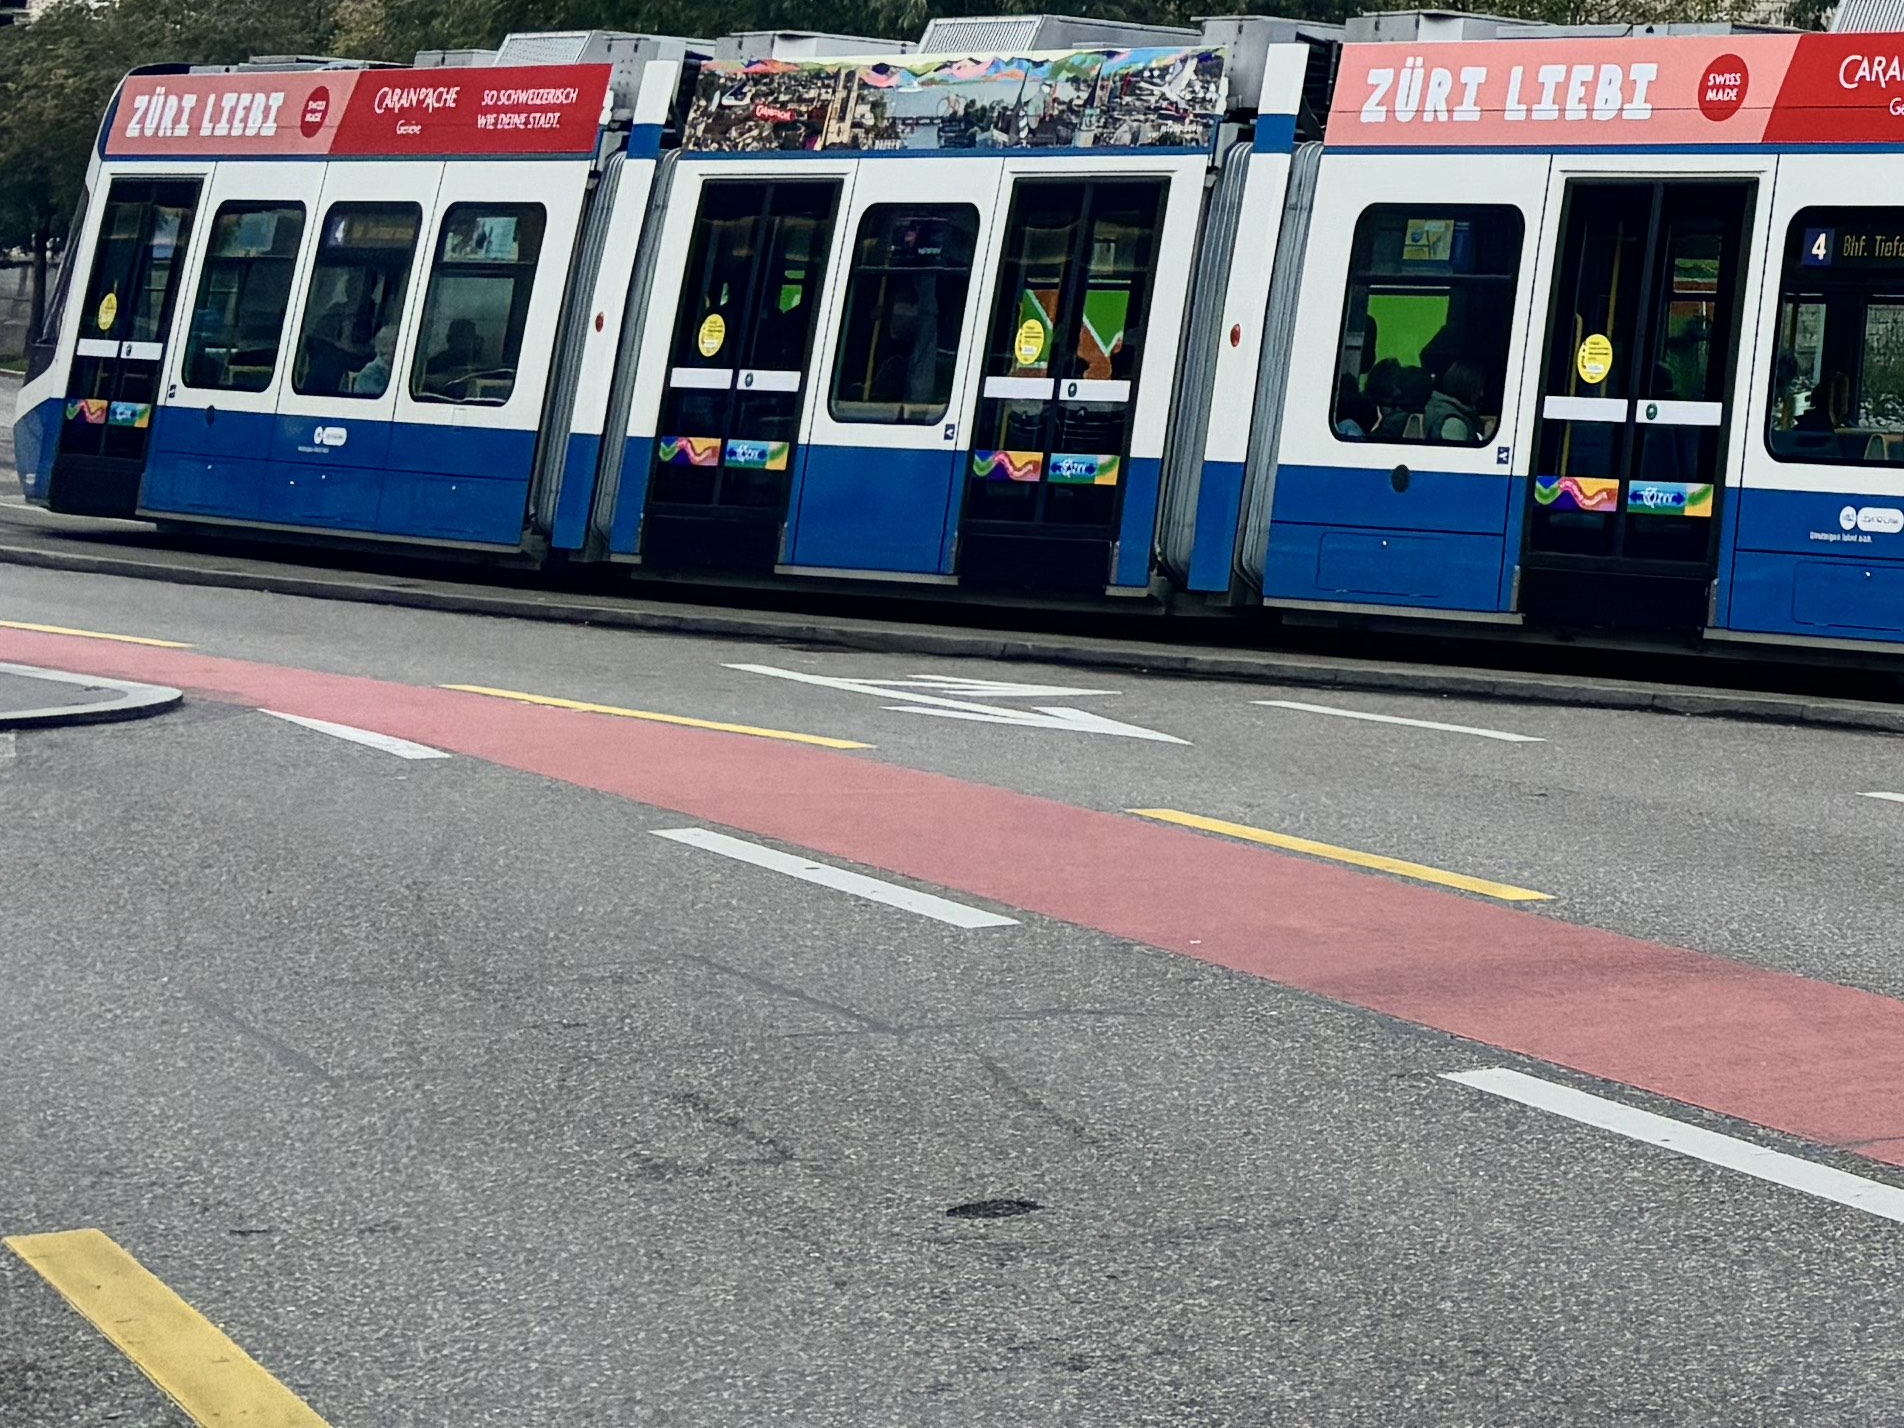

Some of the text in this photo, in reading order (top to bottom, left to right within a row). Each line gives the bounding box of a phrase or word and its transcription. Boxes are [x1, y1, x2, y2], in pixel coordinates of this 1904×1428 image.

[1707, 72, 1742, 87] SWISS
[481, 88, 578, 106] SO SCHWEIZERISCH
[1360, 56, 1658, 123] ZÜRI LIEBI
[1705, 87, 1739, 102] MADE
[125, 86, 198, 137] ZÜRI
[477, 113, 560, 130] WIE DEINE STADT.
[1811, 232, 1827, 261] 4
[1843, 235, 1868, 257] Bhf.
